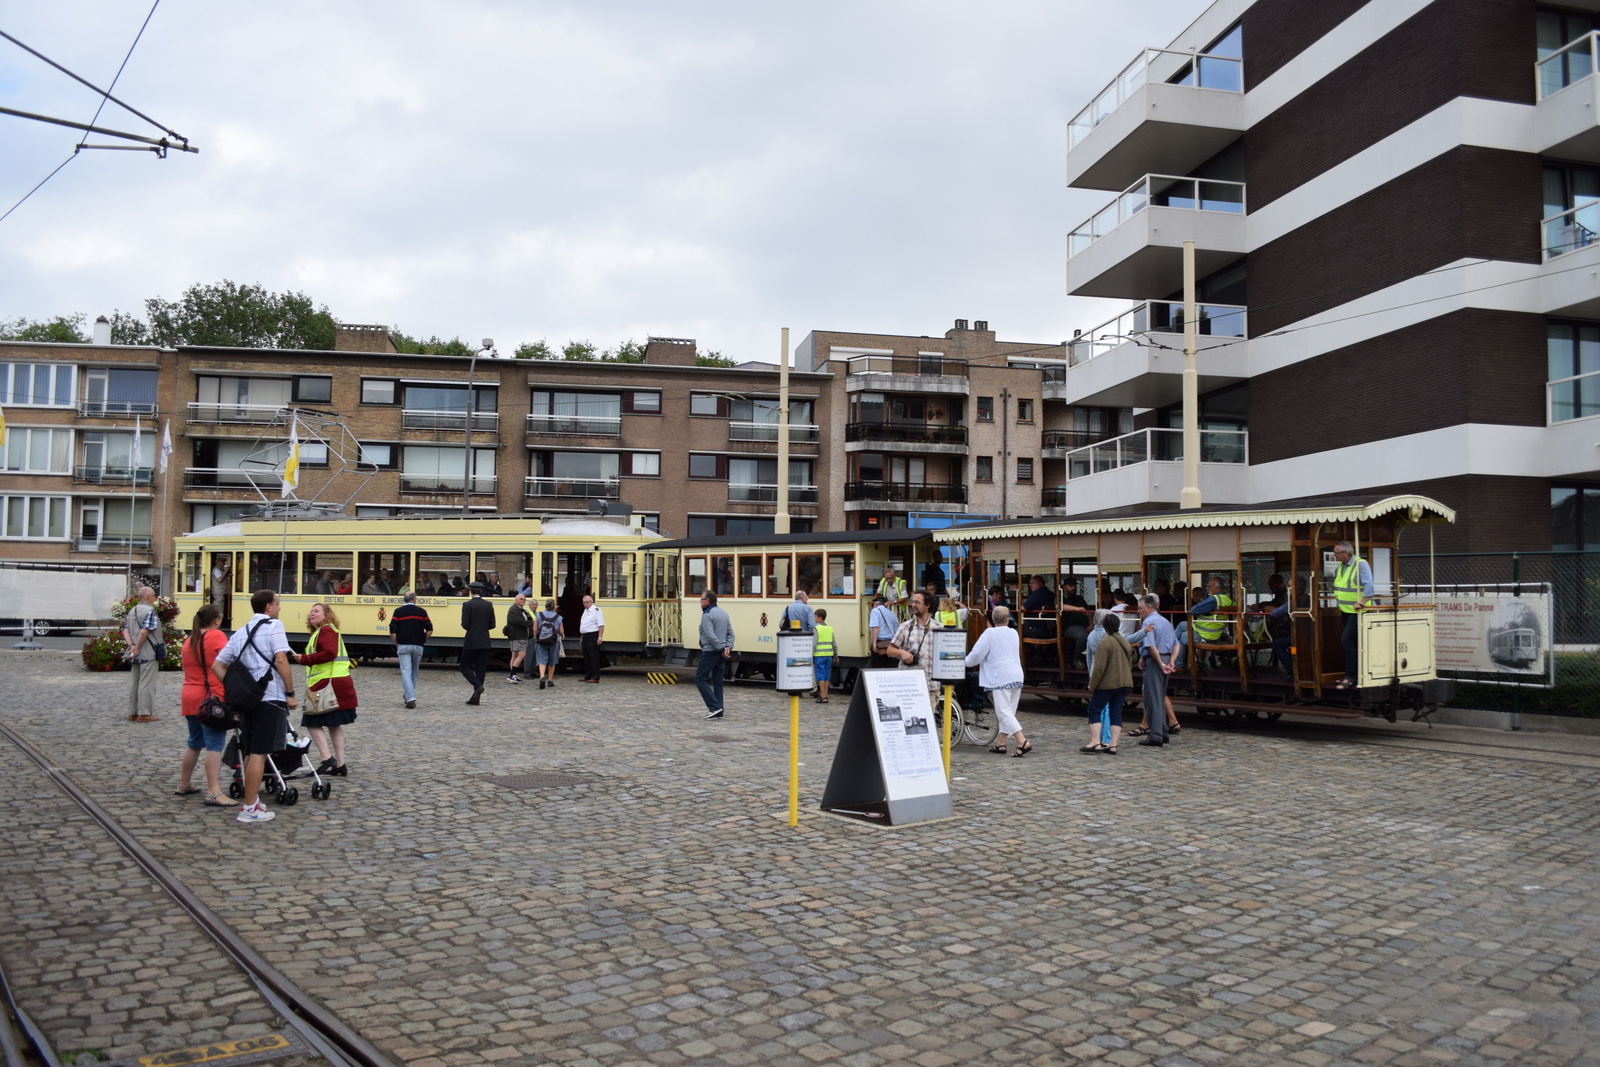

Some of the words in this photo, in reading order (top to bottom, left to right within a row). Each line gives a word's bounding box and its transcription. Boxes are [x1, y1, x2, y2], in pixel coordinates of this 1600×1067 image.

[356, 596, 362, 604] DE
[1440, 602, 1463, 612] TRAMS
[1464, 602, 1472, 612] De
[1473, 602, 1494, 612] Panne
[875, 676, 918, 684] TRAMFESTIVAL
